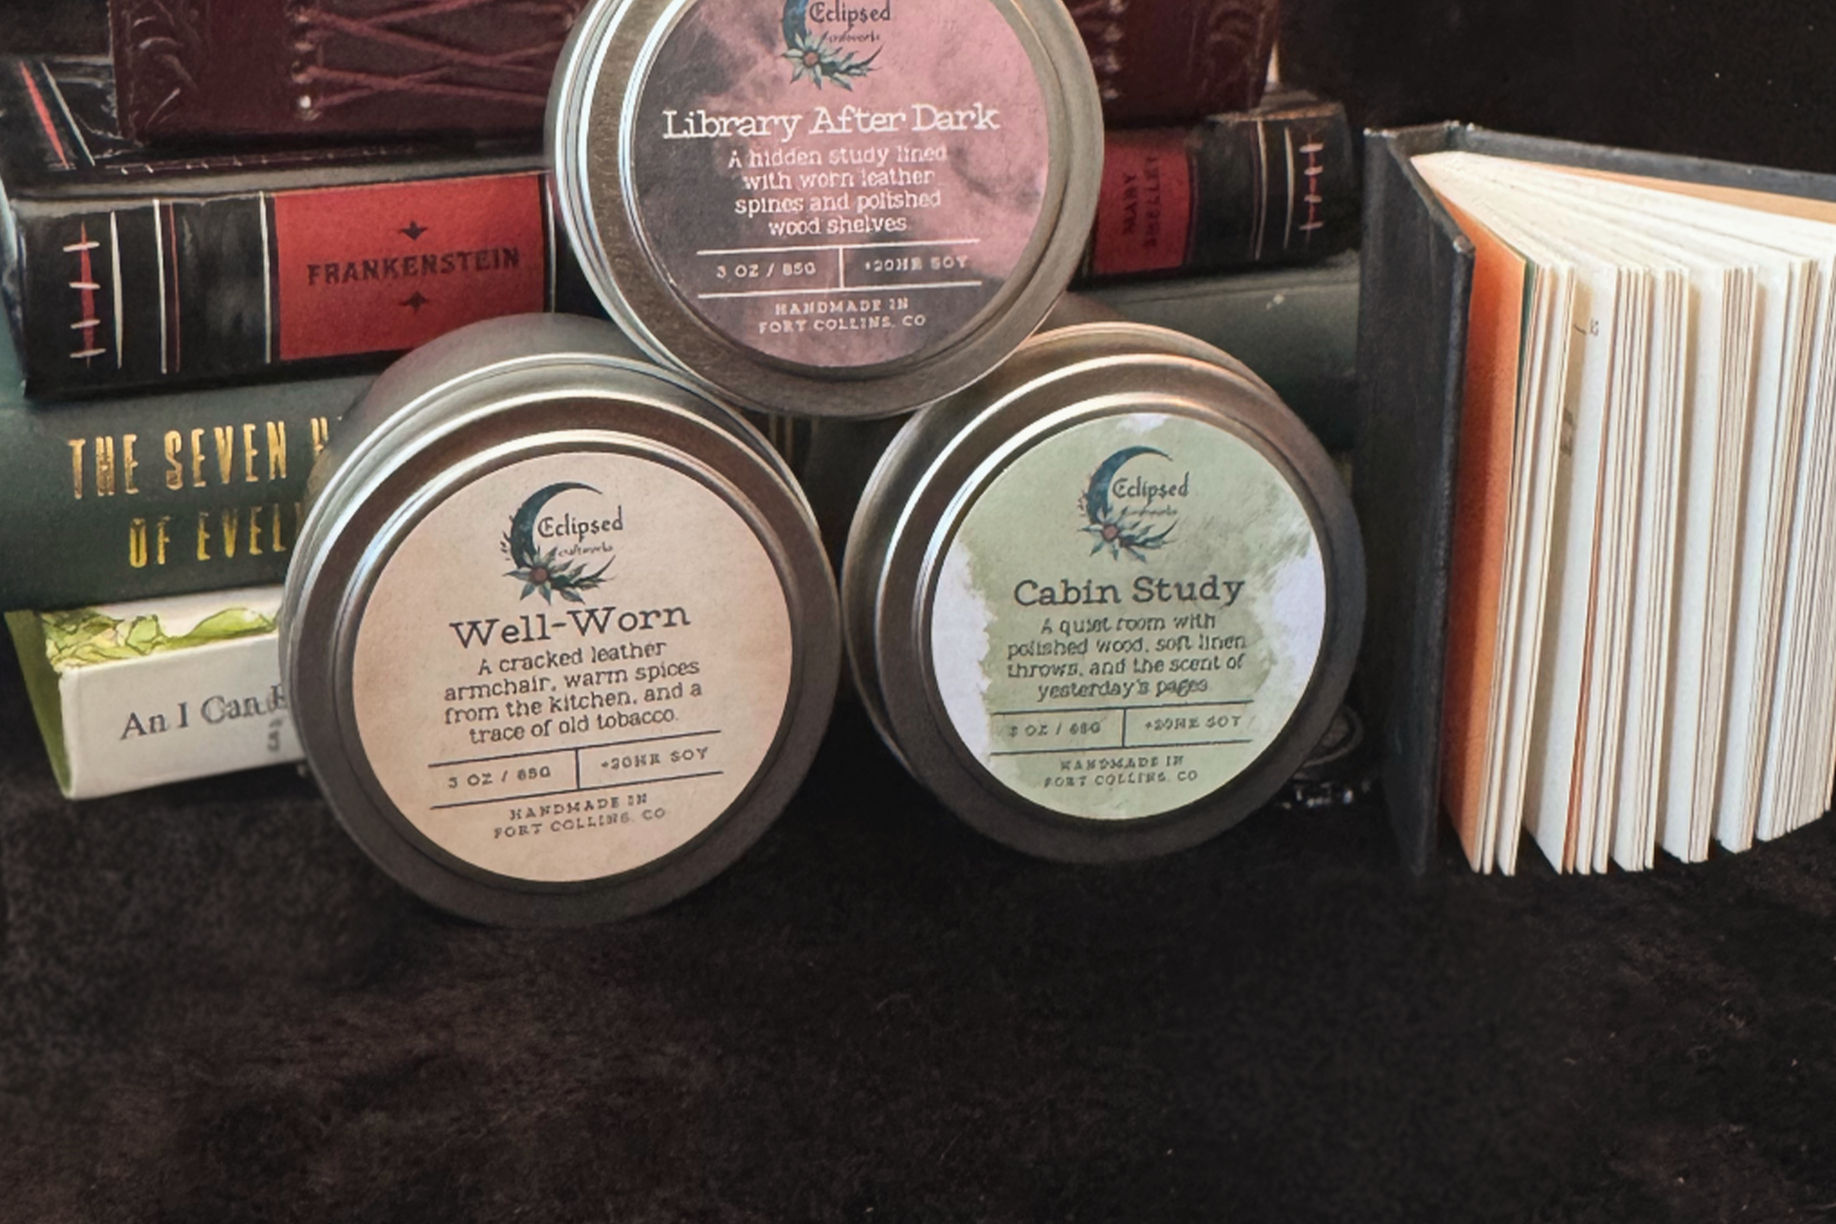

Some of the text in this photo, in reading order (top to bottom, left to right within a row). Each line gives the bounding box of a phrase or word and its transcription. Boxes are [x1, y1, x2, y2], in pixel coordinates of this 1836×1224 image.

[662, 102, 1000, 143] Library After Dark
[728, 144, 947, 168] A hidden study lined
[743, 168, 935, 190] with worn leather
[735, 189, 941, 218] spines and polished
[769, 217, 821, 236] wood
[307, 247, 520, 285] FRANKENSTEIN
[734, 264, 759, 278] OZ
[931, 255, 968, 269] SOY
[774, 297, 909, 316] HANDMADE IN
[758, 319, 806, 334] FORT
[902, 314, 926, 327] CO
[68, 434, 139, 500] THE
[164, 421, 287, 490] SEVEN
[1112, 470, 1190, 505] Eclipsed
[538, 504, 623, 543] Eclipsed
[129, 515, 171, 569] OF
[1014, 574, 1245, 610] Cabin Study
[449, 606, 691, 649] Well-Worn
[1059, 617, 1112, 636] quiet
[1116, 617, 1165, 632] room
[1173, 613, 1216, 630] with
[478, 642, 667, 676] A cracked leather
[1008, 638, 1088, 660] polished
[1155, 635, 1191, 652] soft
[1199, 634, 1247, 651] linen
[564, 669, 628, 688] warm
[635, 661, 700, 683] spices
[1089, 658, 1126, 676] and
[1133, 658, 1164, 673] the
[1168, 655, 1221, 673] scent
[1226, 653, 1246, 669] of
[445, 706, 499, 725] from
[506, 699, 542, 718] the
[644, 682, 683, 703] and
[690, 683, 702, 697] a
[1037, 678, 1149, 702] yesterday's
[120, 712, 168, 741] An
[177, 701, 190, 728] I
[201, 695, 266, 724] Can
[469, 726, 525, 744] trace
[531, 719, 553, 737] of
[559, 715, 589, 734] old
[670, 747, 709, 762] SOY
[1061, 754, 1185, 772] HANDMADE IN
[467, 773, 493, 787] OZ
[1044, 774, 1086, 788] FORT
[1177, 770, 1198, 783] CO
[510, 792, 648, 821] HANDMADE IN
[494, 823, 542, 840] FORT
[642, 807, 666, 822] CO
